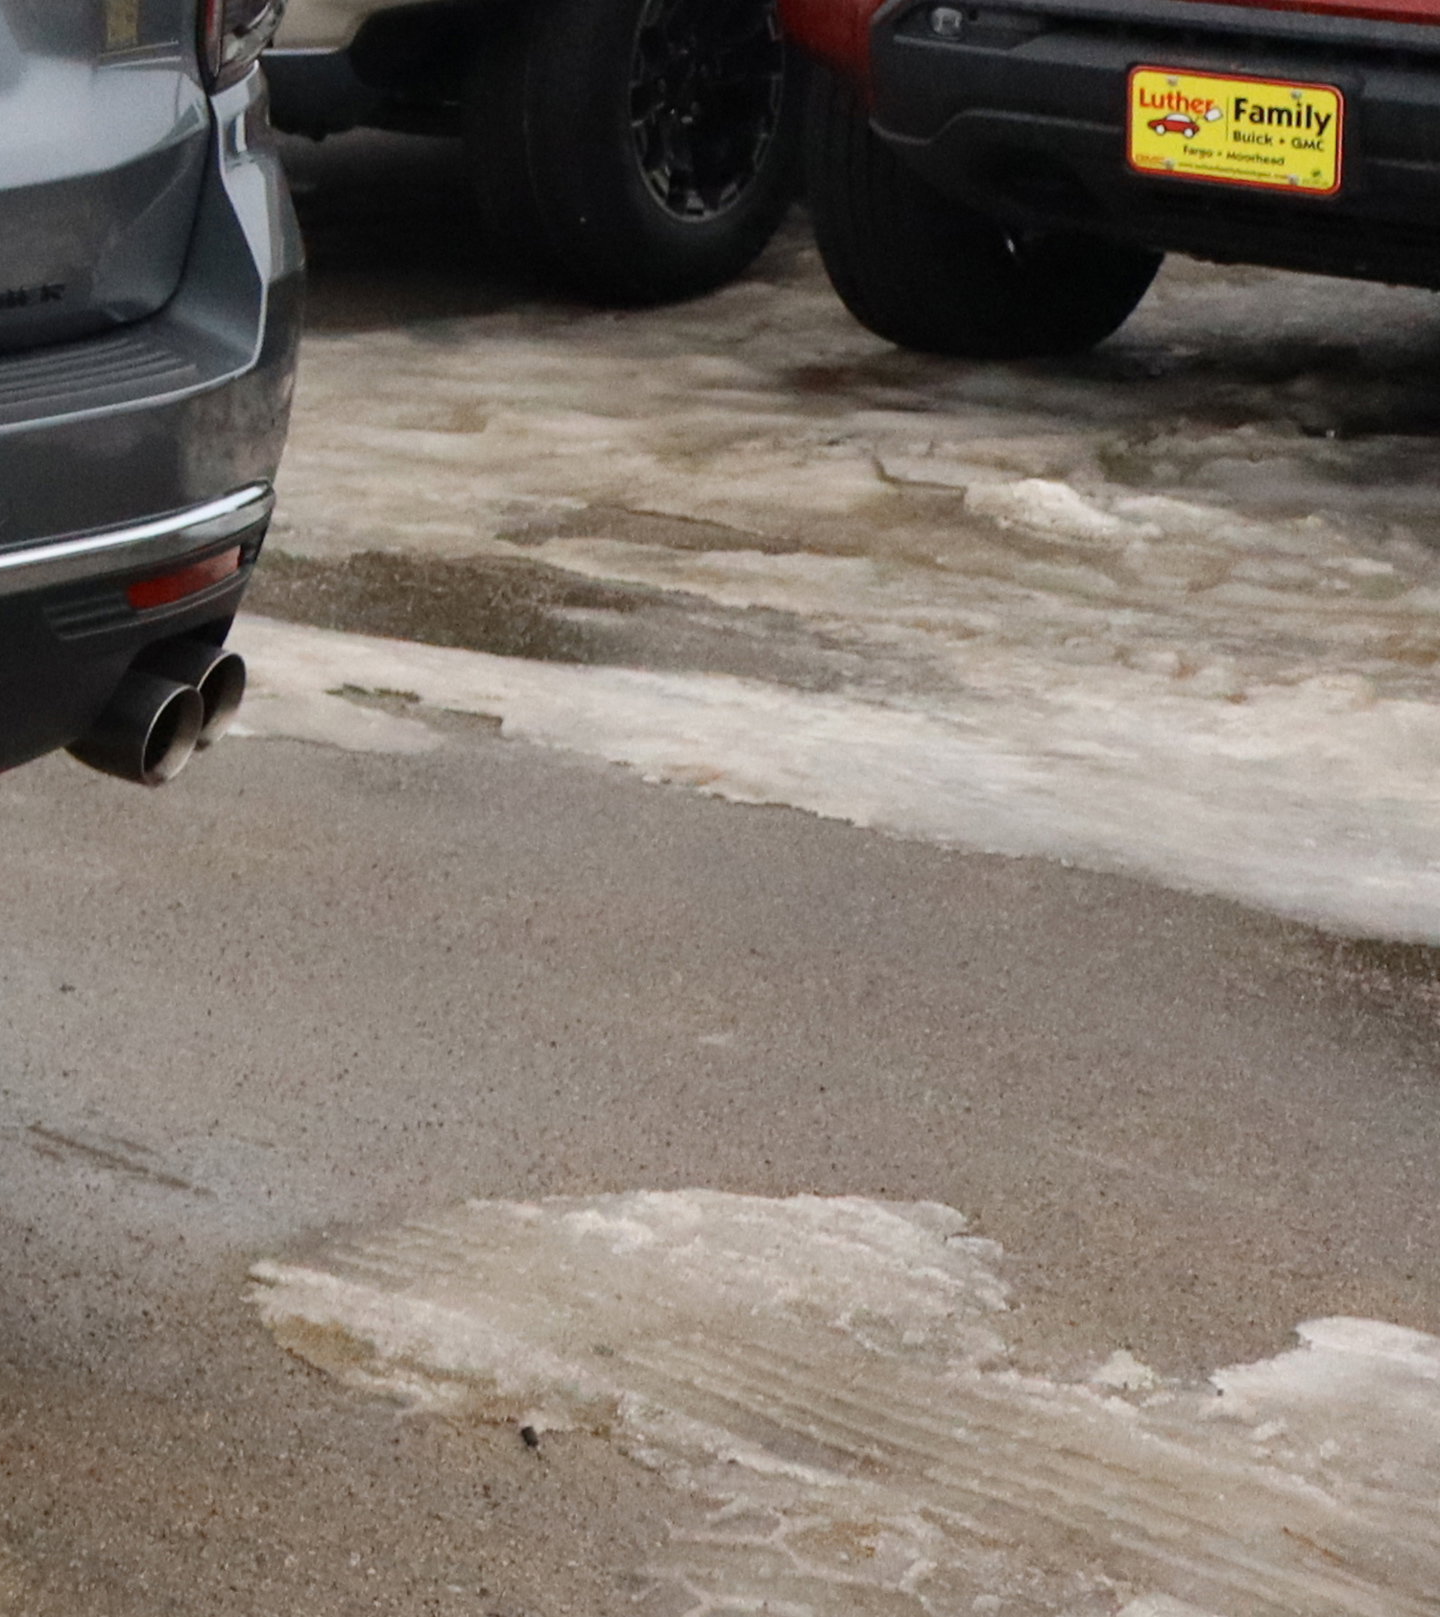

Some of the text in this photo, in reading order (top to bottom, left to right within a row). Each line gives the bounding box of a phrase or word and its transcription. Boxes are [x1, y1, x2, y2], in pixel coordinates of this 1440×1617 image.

[1139, 88, 1332, 136] Luther Family
[1233, 130, 1325, 152] Buick GMC
[1183, 145, 1285, 166] Fargo Moorhead
